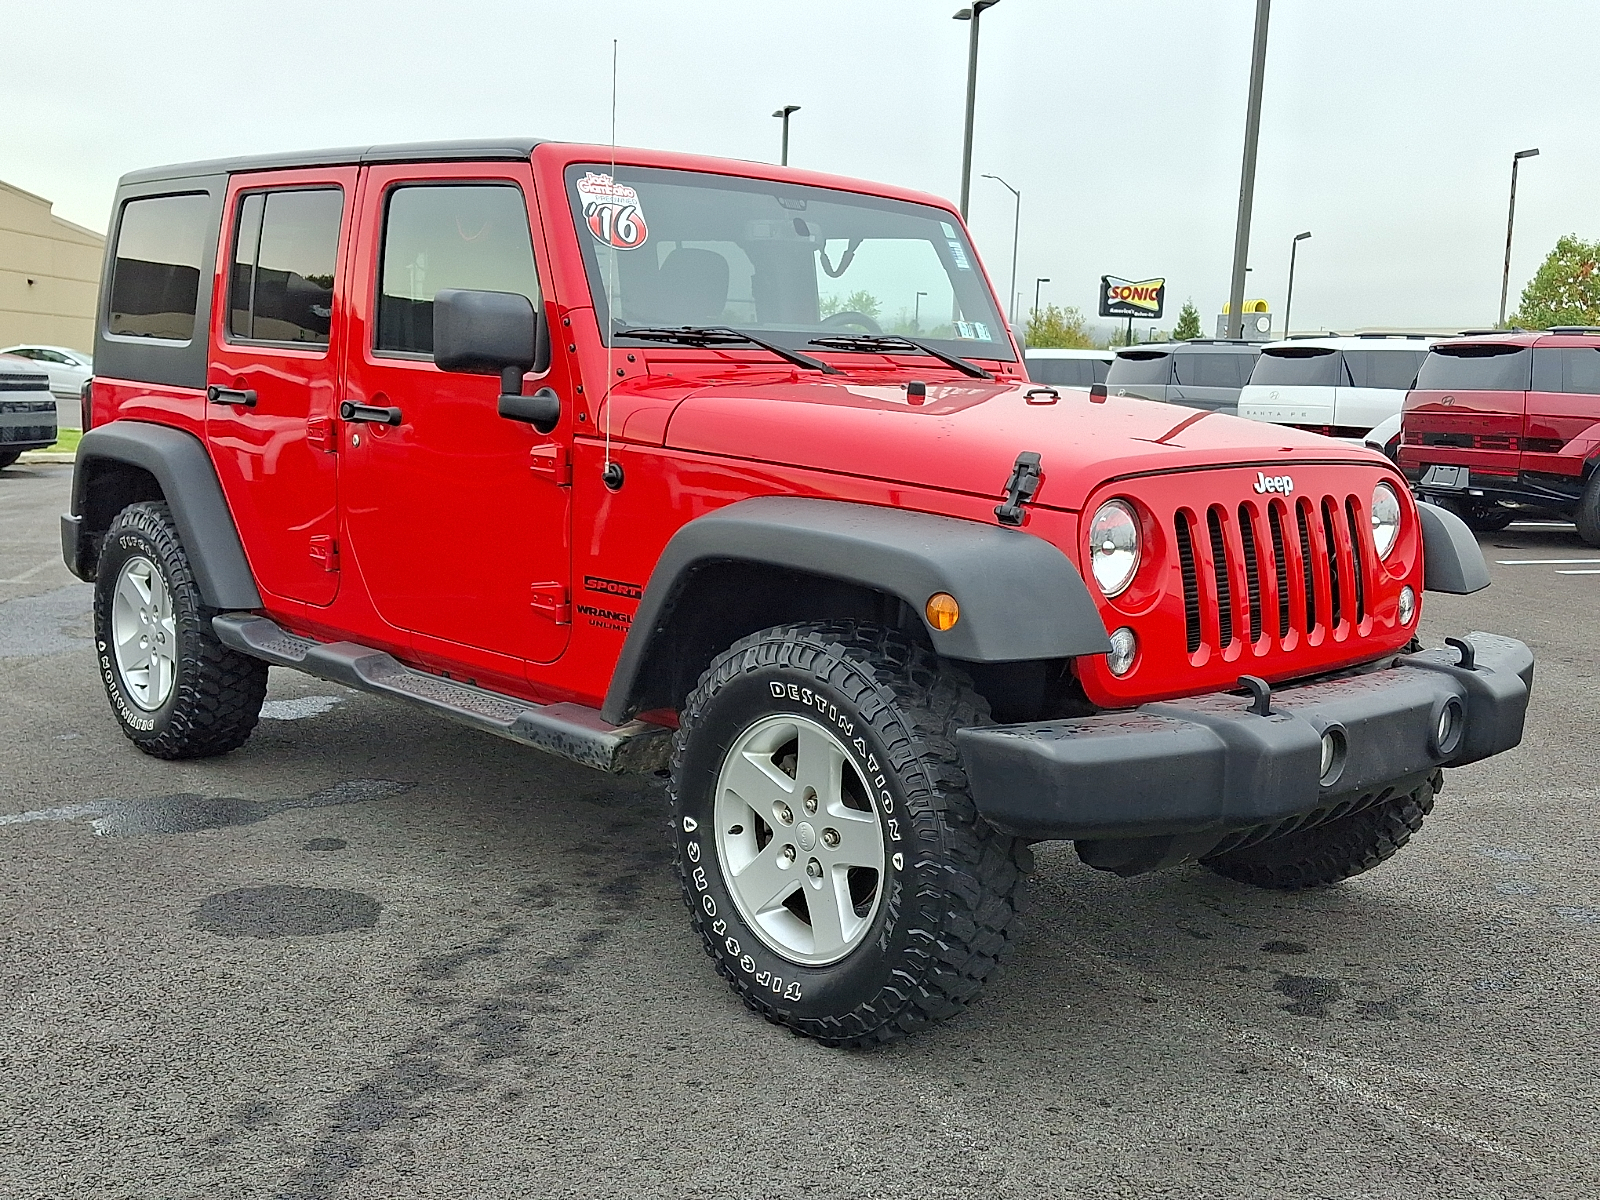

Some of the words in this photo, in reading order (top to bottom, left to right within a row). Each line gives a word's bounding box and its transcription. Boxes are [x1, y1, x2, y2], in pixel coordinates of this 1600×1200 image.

[1111, 286, 1160, 301] SONIC
[1253, 471, 1294, 497] Jeep
[587, 579, 637, 595] SPORT
[769, 681, 901, 842] DESTINATION
